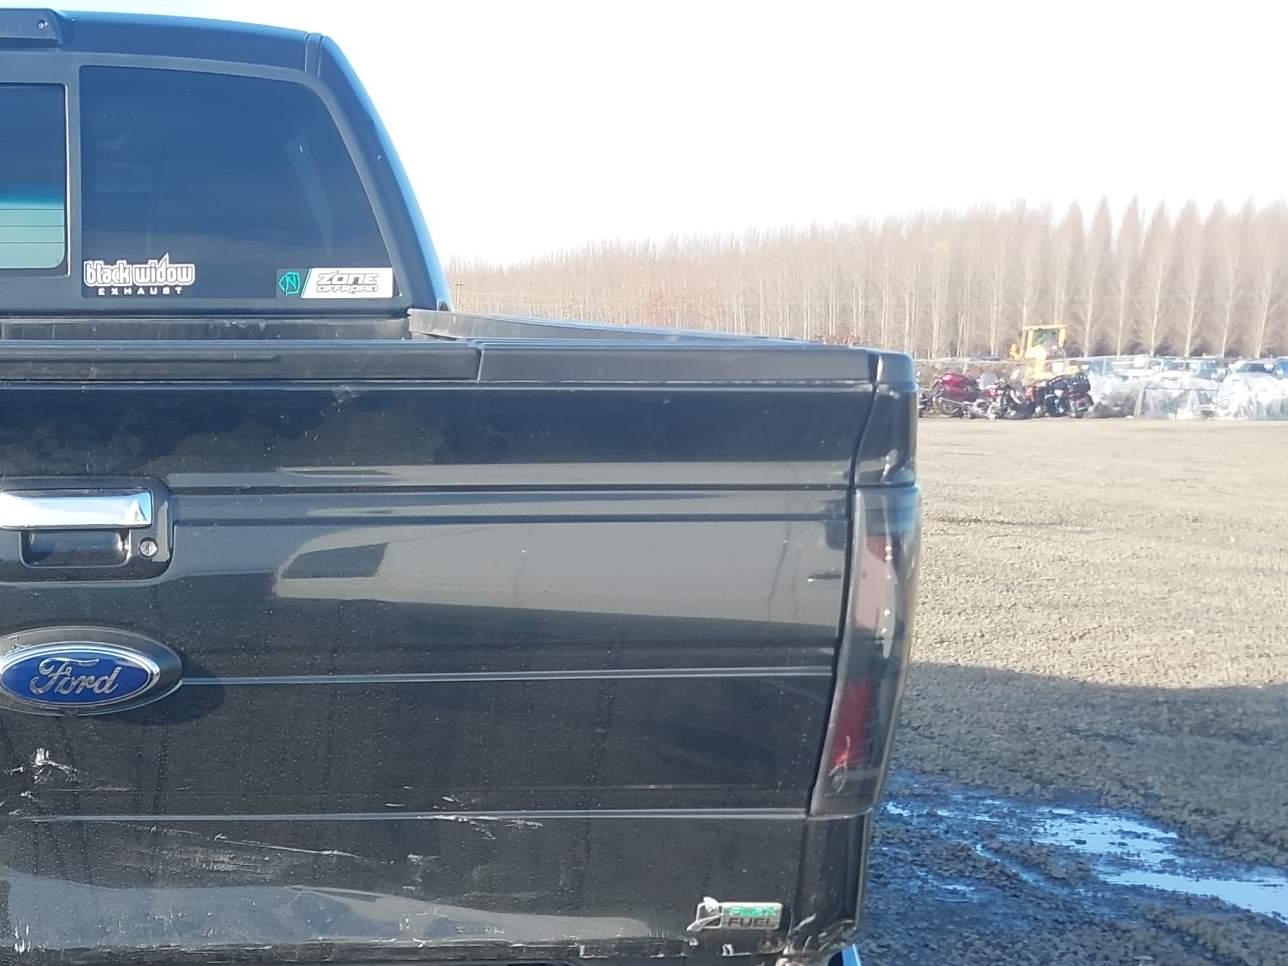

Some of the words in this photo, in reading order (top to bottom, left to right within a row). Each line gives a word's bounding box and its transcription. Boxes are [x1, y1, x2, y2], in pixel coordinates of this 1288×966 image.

[85, 260, 132, 286] black
[133, 253, 195, 286] widow
[98, 287, 182, 296] EXHAUST
[29, 657, 122, 694] Ford
[728, 917, 776, 928] FUEL
